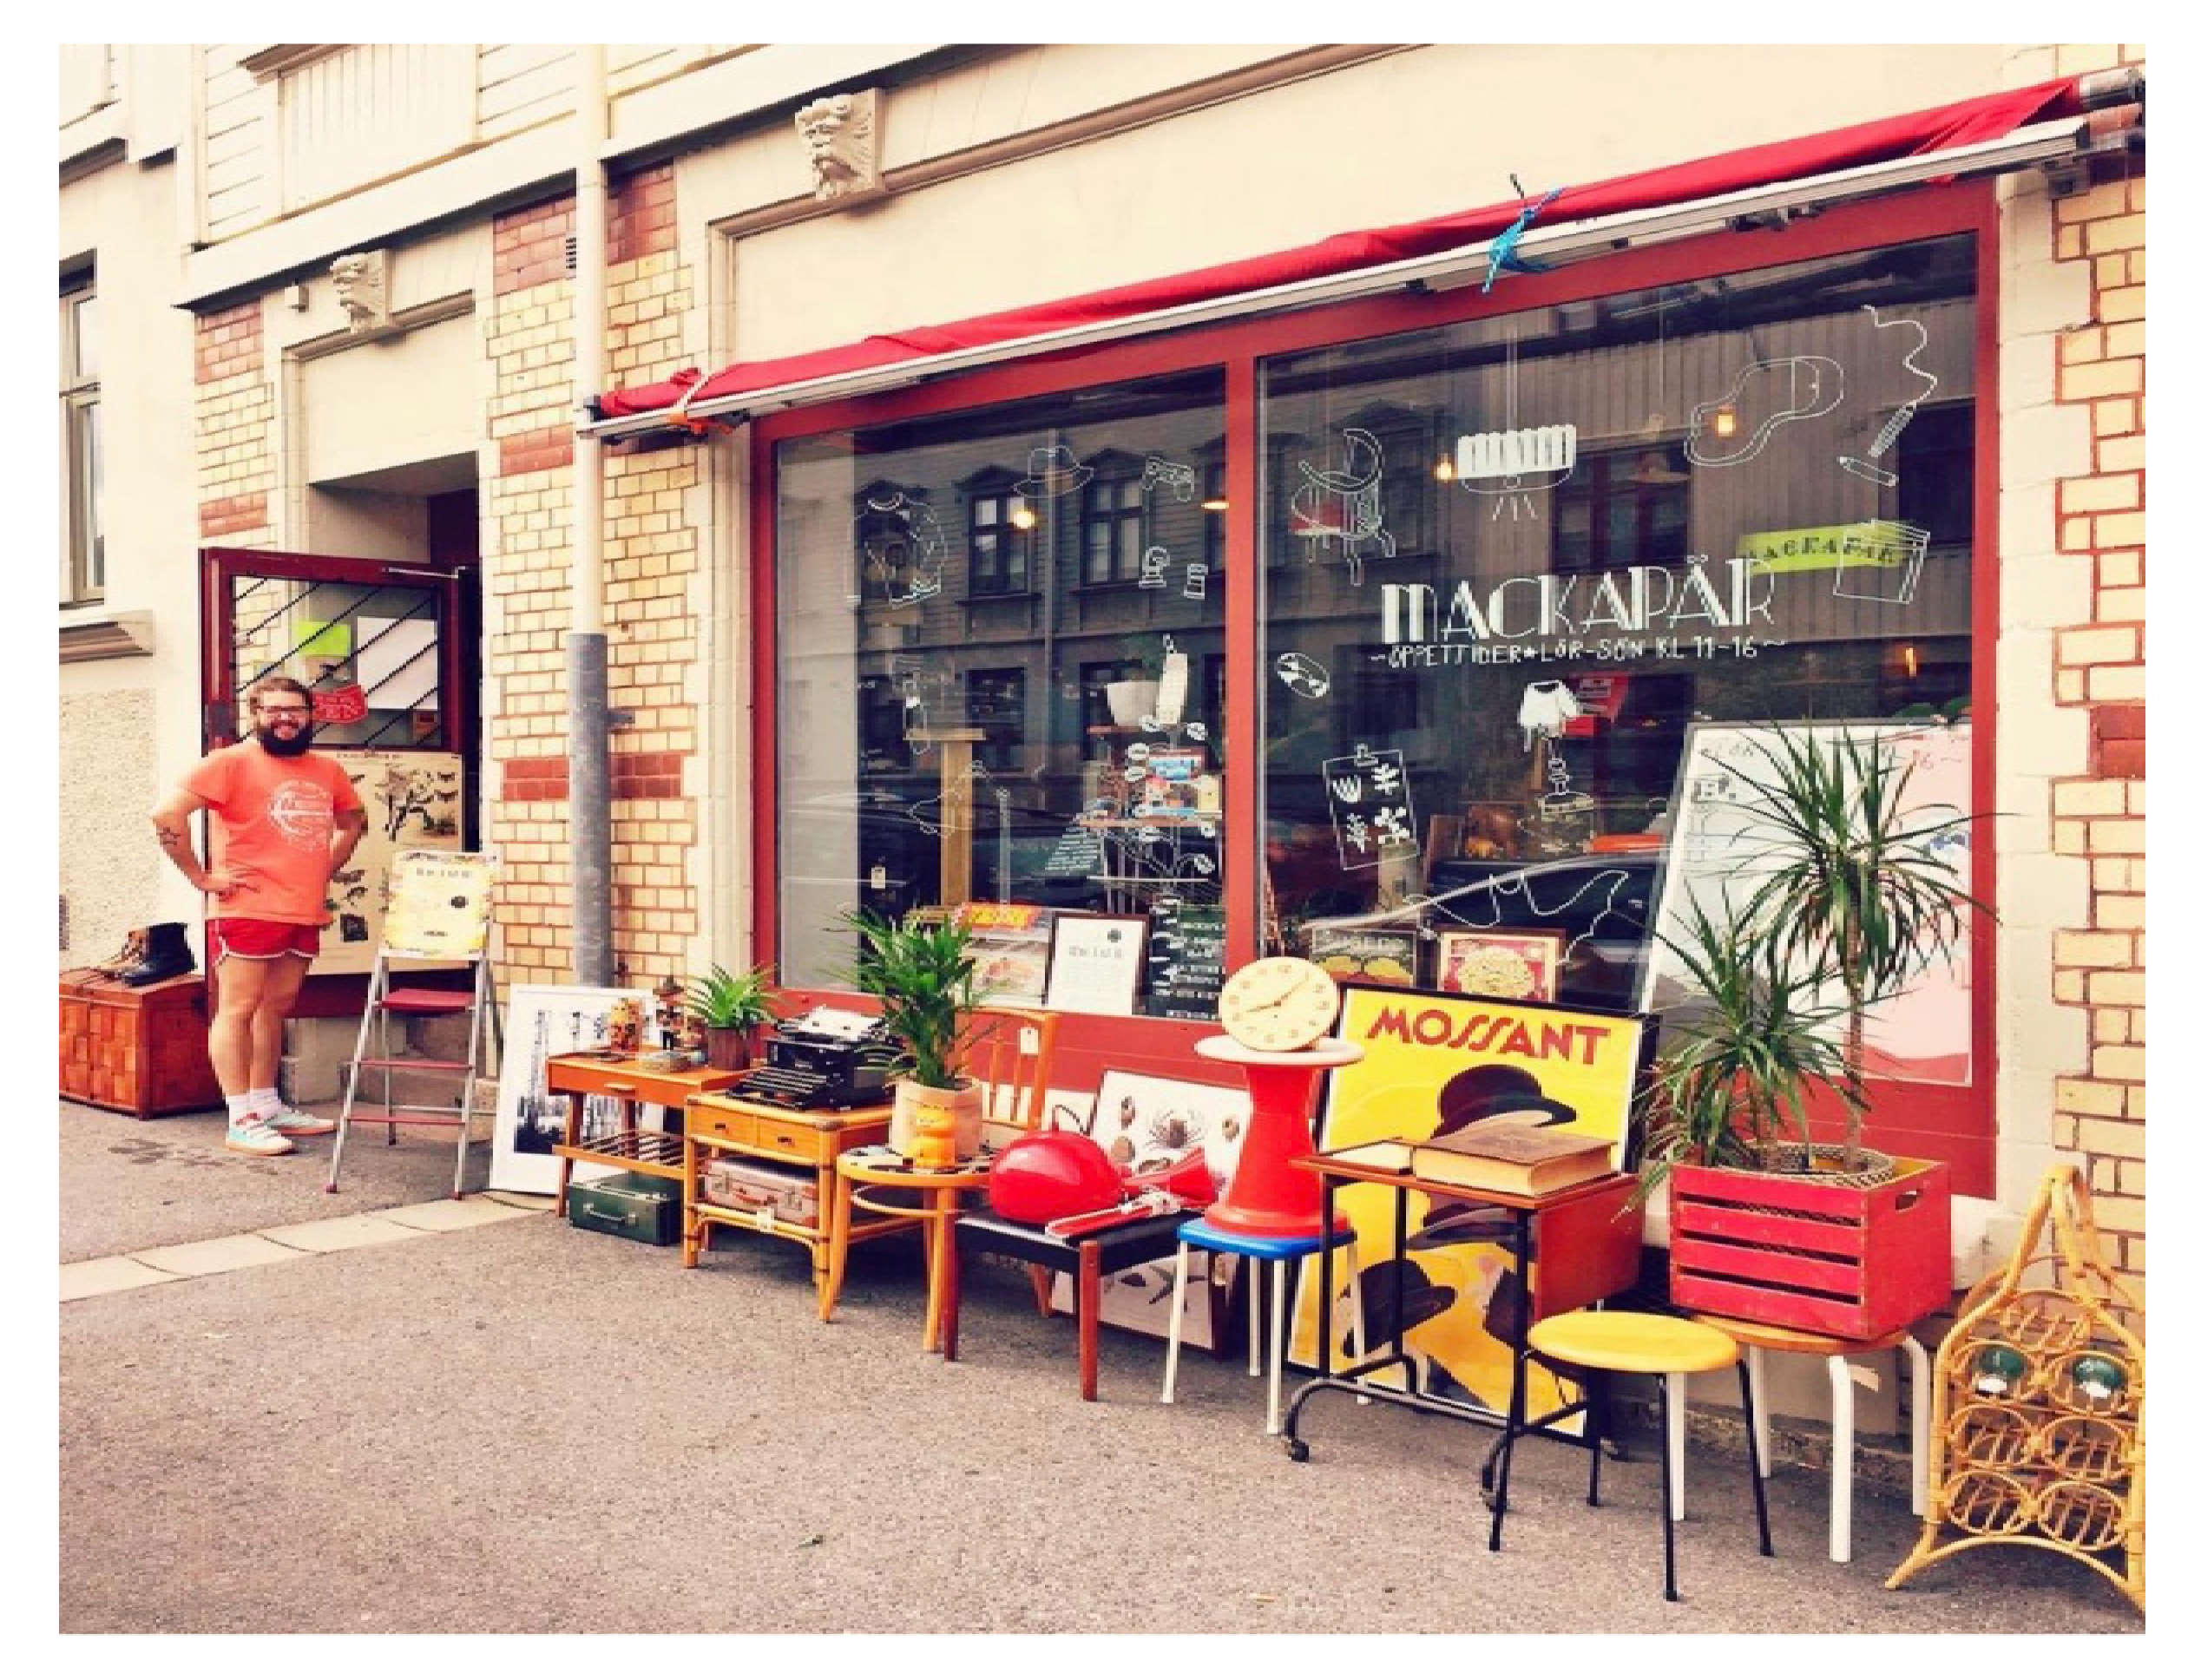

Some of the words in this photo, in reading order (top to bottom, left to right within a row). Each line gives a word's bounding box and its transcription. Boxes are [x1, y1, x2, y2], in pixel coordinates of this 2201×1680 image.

[1382, 555, 1775, 644] MACKAPÄR
[1655, 636, 1685, 660] KL
[1365, 1006, 1612, 1066] MOSSANT
